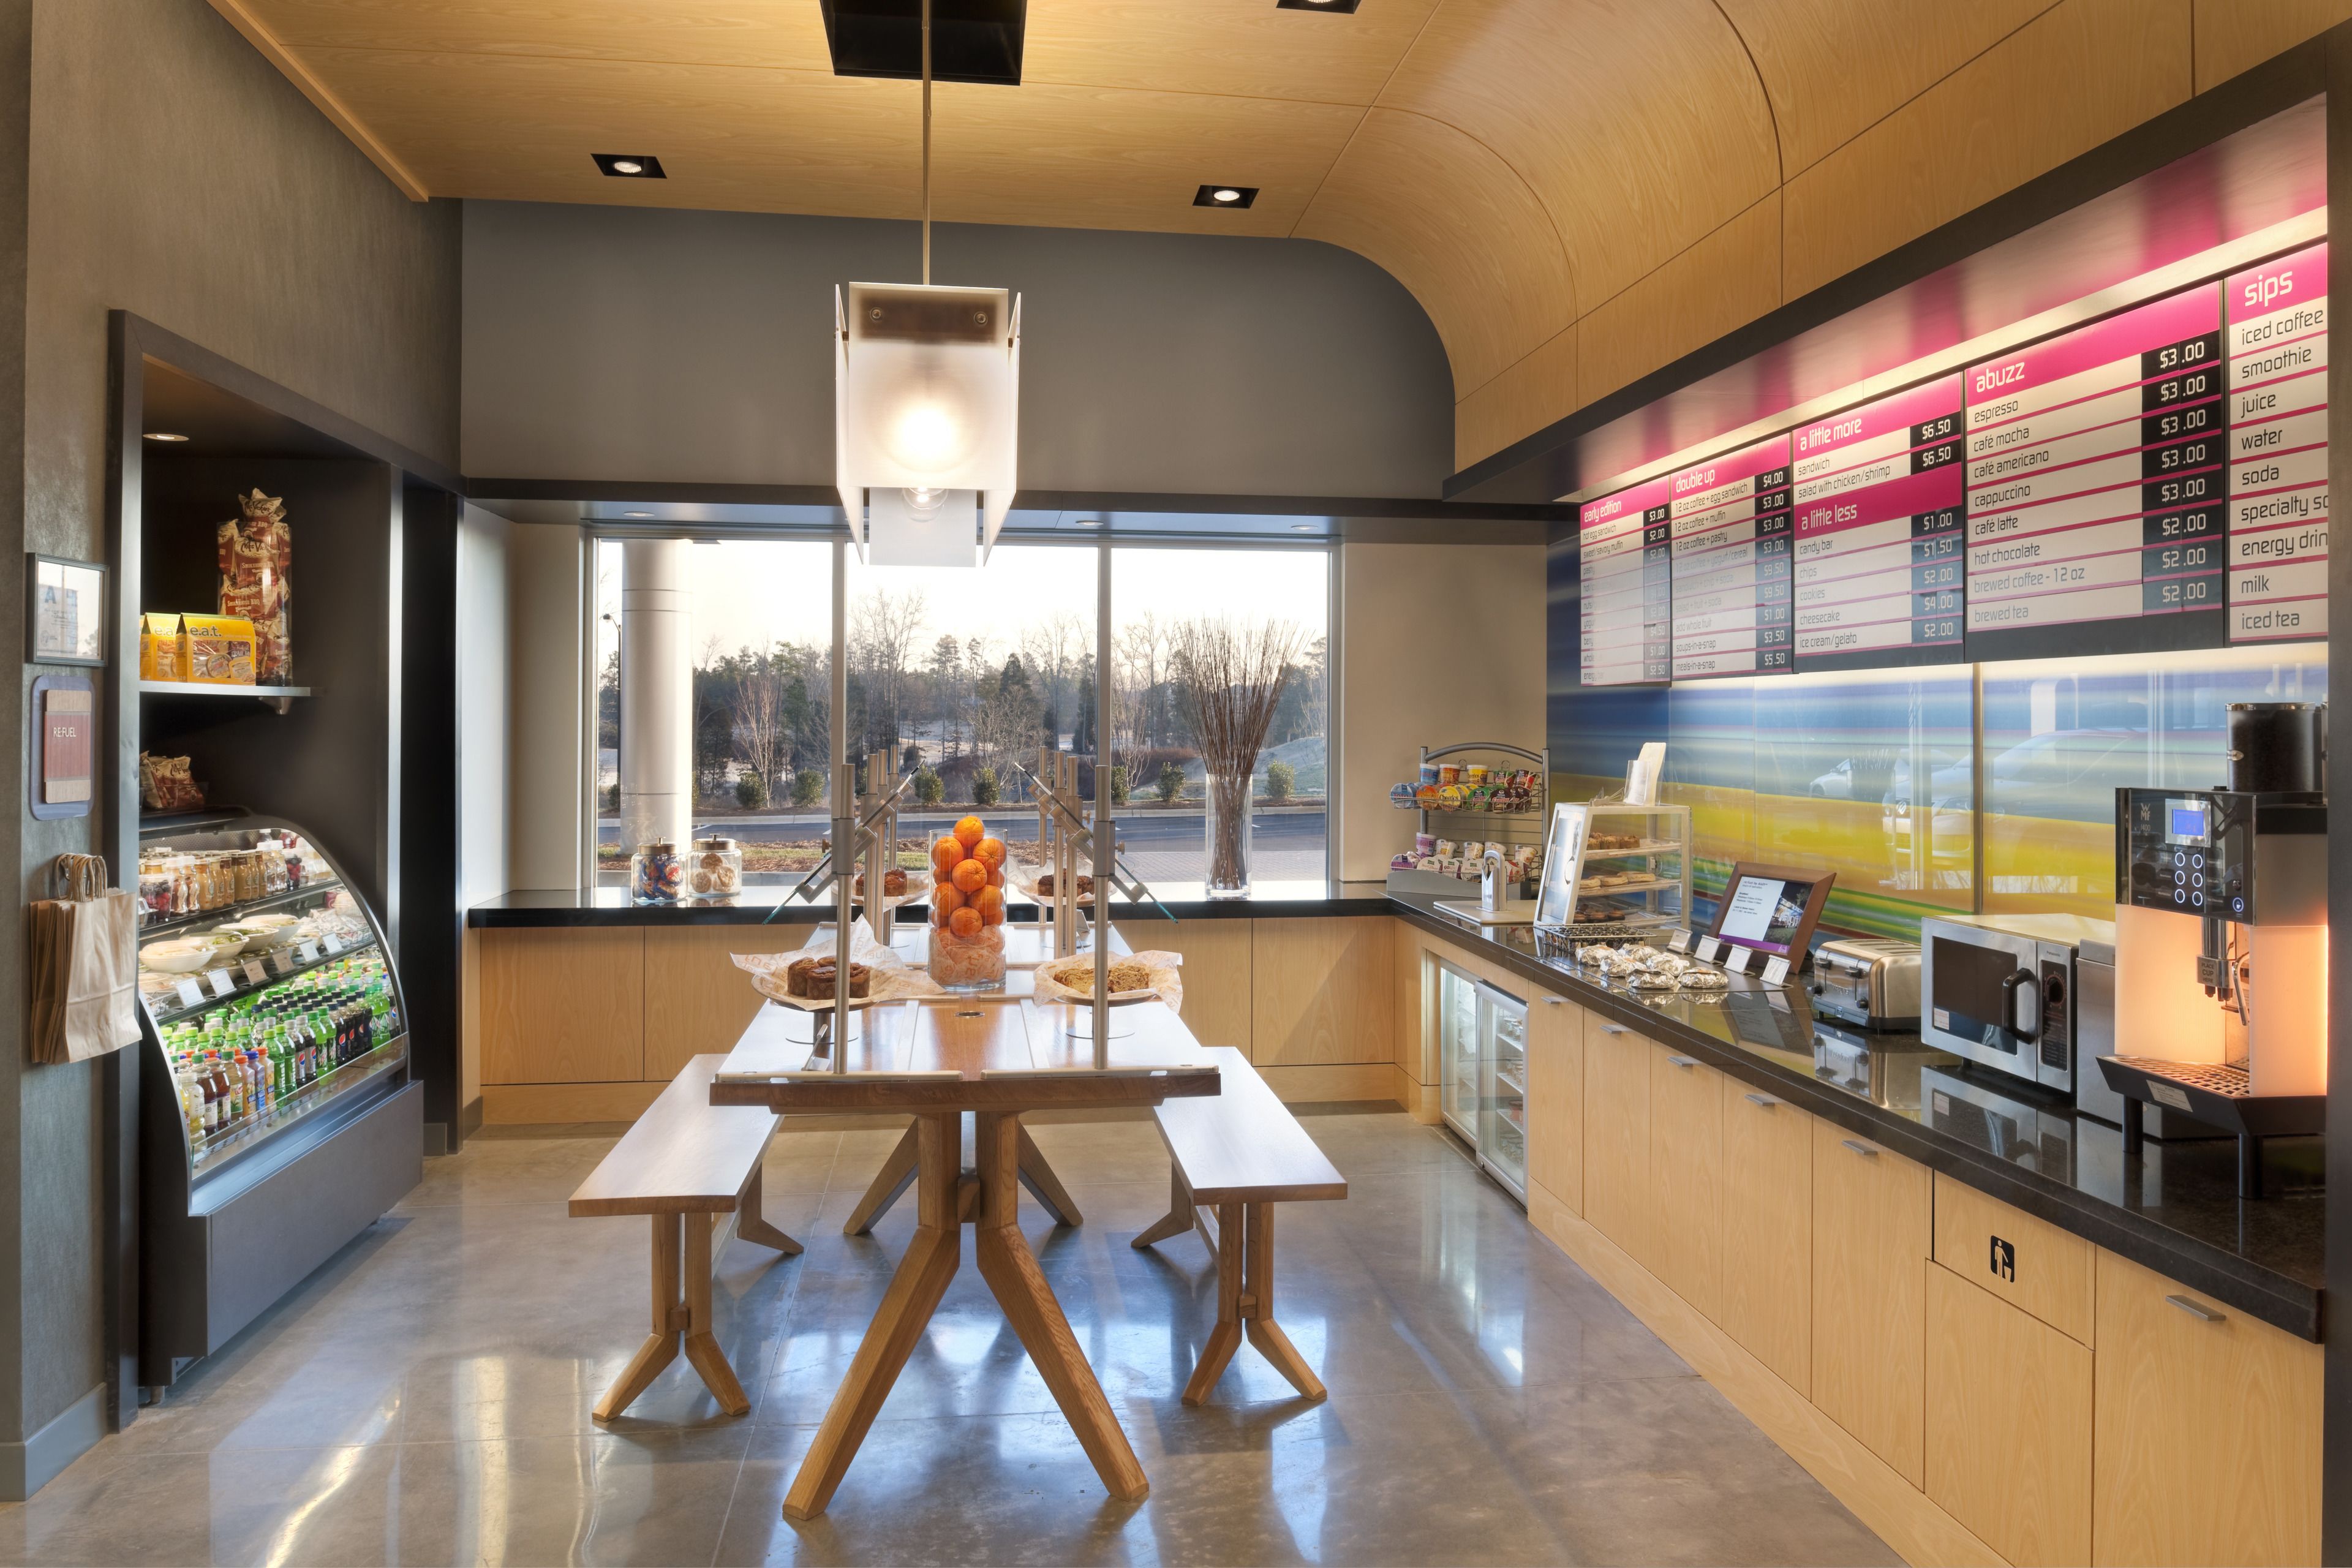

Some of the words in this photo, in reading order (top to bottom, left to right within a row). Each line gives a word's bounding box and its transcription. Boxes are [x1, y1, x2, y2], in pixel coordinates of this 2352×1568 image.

[2244, 271, 2293, 307] sips
[2242, 320, 2271, 345] iced
[2276, 309, 2324, 335] coffee
[1976, 361, 2025, 393] abuzz
[2242, 347, 2312, 379] smoothie
[1975, 400, 2018, 423] espresso
[2160, 341, 2204, 369] $3.00
[1974, 434, 1993, 452] café
[1996, 426, 2029, 447] mocha
[2161, 375, 2205, 402] $3.00
[2241, 393, 2276, 418] juice
[1798, 457, 1830, 476] sandwich
[1922, 419, 1950, 440] $6.50
[1800, 436, 1807, 451] a
[1809, 428, 1831, 448] little
[1833, 418, 1862, 440] more
[1975, 461, 1994, 478] café
[1997, 450, 2049, 473] americano
[2161, 409, 2206, 436] $3.00
[2241, 429, 2283, 450] water
[1676, 471, 1702, 492] double
[1705, 469, 1715, 486] up
[1798, 482, 1817, 498] salad
[1818, 480, 1831, 493] with
[1834, 466, 1890, 489] chicken/shrimp
[1923, 446, 1951, 467] $6.50
[1975, 484, 2030, 507] cappuccino
[2162, 443, 2205, 470] $3.00
[2242, 464, 2279, 485] soda
[1676, 502, 1682, 513] 12
[1683, 499, 1689, 508] oz
[1691, 496, 1705, 508] coffee
[1711, 492, 1721, 503] egg
[1722, 482, 1747, 499] sandwich
[1763, 471, 1783, 488] $4.00
[1975, 519, 1995, 535] café
[1998, 514, 2018, 531] latte
[2162, 478, 2205, 503] $3.00
[1585, 507, 1599, 522] early
[1600, 500, 1621, 517] edition
[1598, 524, 1616, 536] sandwich
[1649, 508, 1664, 521] $3.00
[1675, 522, 1681, 532] 12
[1683, 521, 1689, 530] oz
[1689, 516, 1704, 527] coffee
[1710, 510, 1725, 523] muffin
[1763, 494, 1784, 509] $3.00
[1801, 516, 1807, 530] a
[1811, 508, 1832, 529] little
[1835, 504, 1857, 523] less
[2241, 496, 2309, 524] specialty
[1650, 528, 1665, 541] $2.00
[1676, 542, 1682, 552] 12
[1683, 540, 1689, 549] oz
[1691, 537, 1705, 549] coffee
[1711, 530, 1727, 545] pastry
[1764, 516, 1784, 532] $3.00
[1764, 540, 1784, 553] $3.00
[1800, 542, 1820, 555] candy
[1822, 539, 1833, 550] bar
[1924, 513, 1952, 530] $1.00
[1975, 551, 1989, 565] hot
[1992, 543, 2040, 563] chocolate
[2162, 513, 2206, 537] $2.00
[2242, 537, 2294, 556] energy
[1764, 562, 1784, 576] $9.50
[1800, 566, 1817, 580] chips
[1924, 539, 1952, 557] $1.50
[1975, 575, 2010, 593] brewed
[2013, 569, 2043, 588] coffee
[2054, 567, 2068, 582] 12
[2071, 567, 2085, 581] oz
[2162, 548, 2206, 569] $2.00
[1764, 585, 1784, 598] $9.50
[1800, 587, 1825, 601] cookies
[1924, 568, 1953, 584] $2.00
[2242, 575, 2270, 594] milk
[1800, 610, 1840, 625] cheesecake
[1924, 595, 1953, 611] $4.00
[1975, 605, 2010, 623] brewed
[2013, 605, 2029, 619] tea
[2162, 582, 2206, 603] $2.00
[190, 625, 222, 637] e.a.t.
[1687, 619, 1701, 630] whole
[1702, 618, 1711, 628] fruit
[1765, 608, 1784, 620] $1.00
[2242, 611, 2271, 630] iced
[2276, 610, 2300, 627] tea
[1676, 639, 1716, 653] soups-in-a-snap
[1765, 630, 1784, 643] $3.50
[1800, 636, 1809, 648] ice
[1811, 633, 1857, 648] cream/gelato
[1924, 622, 1953, 638] $2.00
[1676, 660, 1715, 672] meals-in-a-snap
[1765, 653, 1785, 665] $5.50
